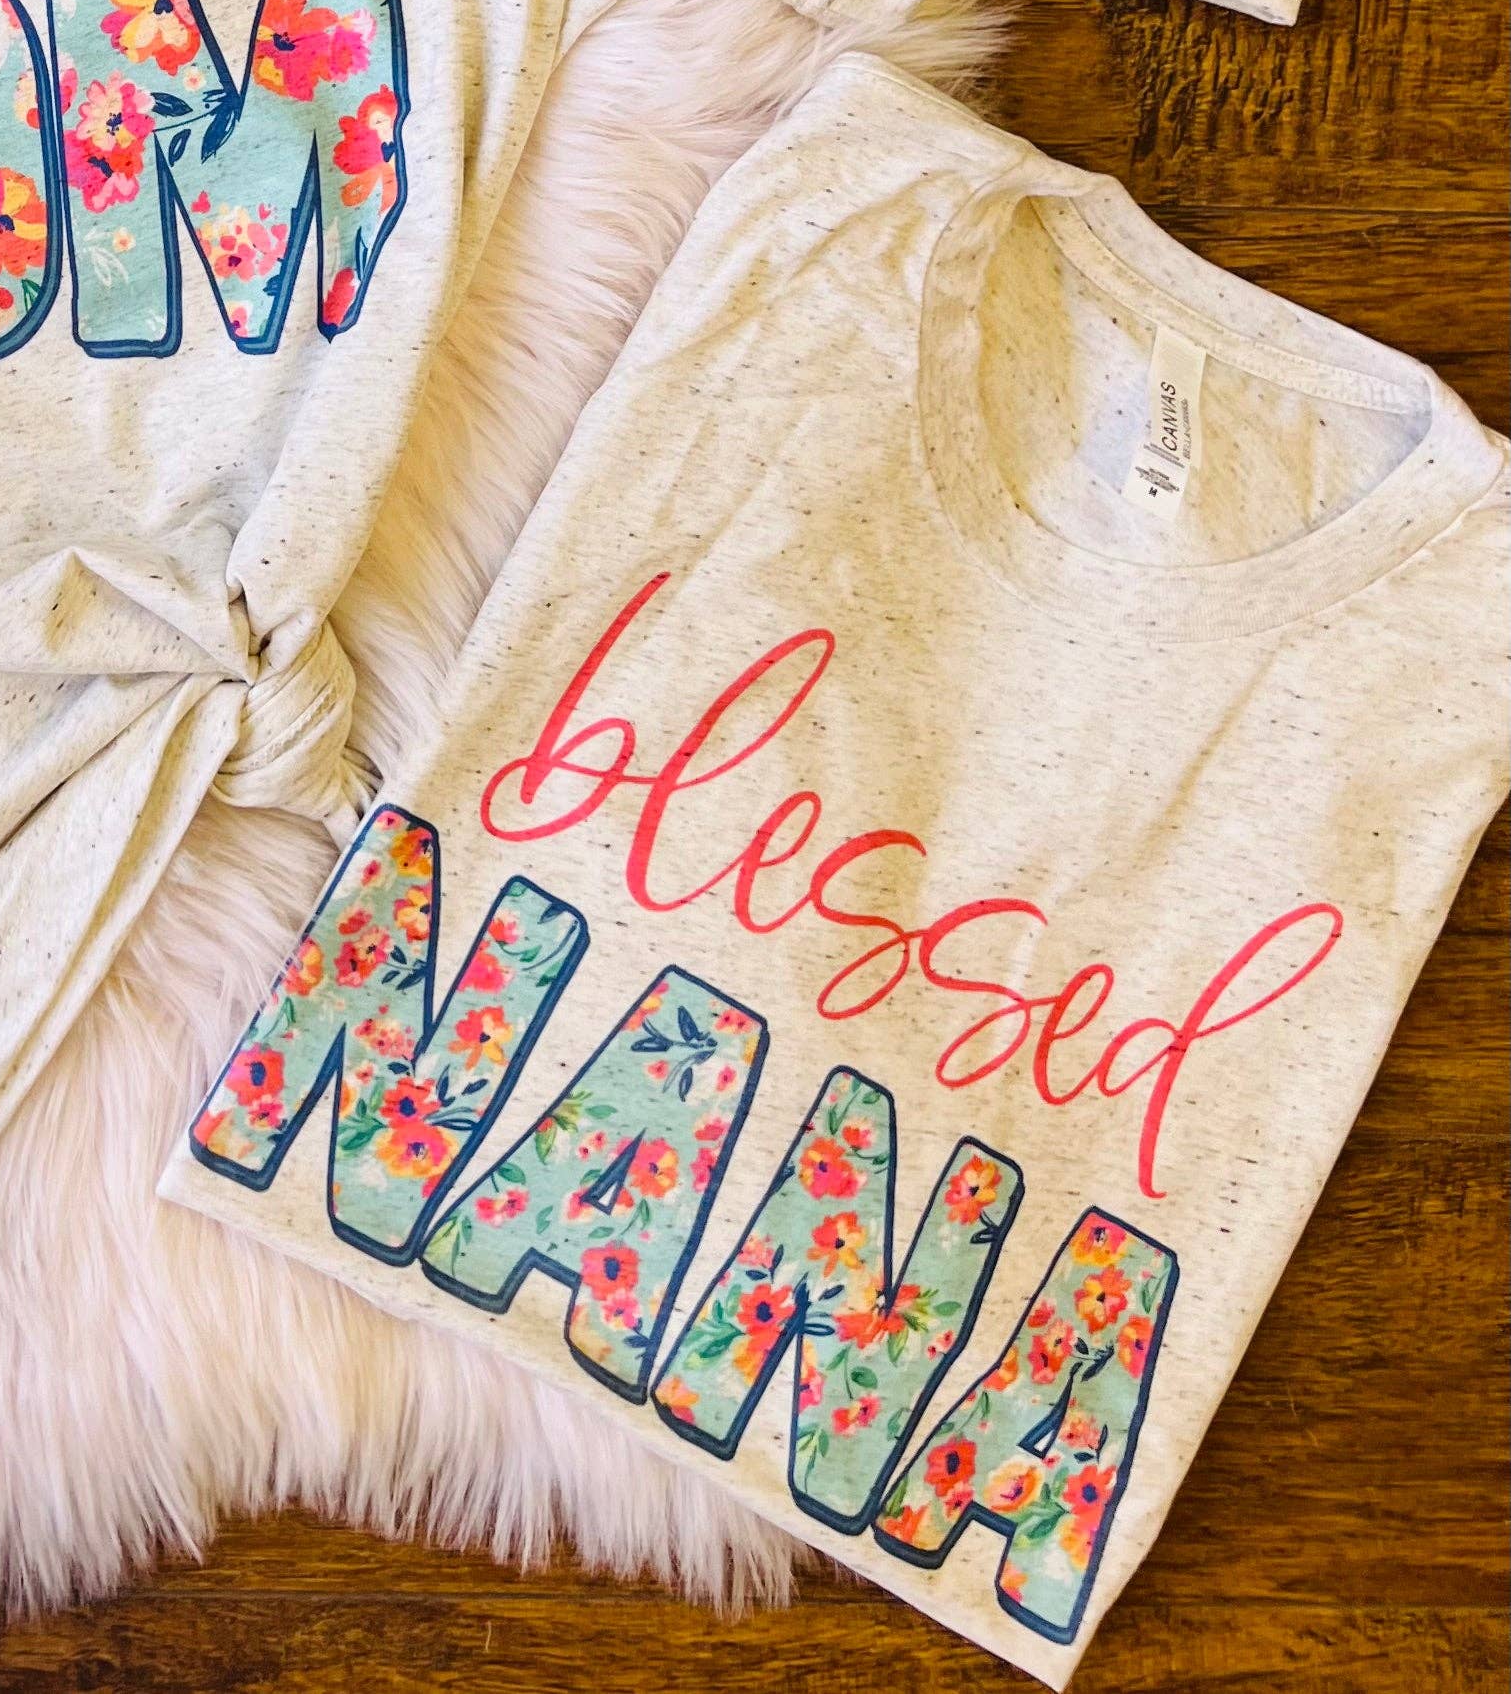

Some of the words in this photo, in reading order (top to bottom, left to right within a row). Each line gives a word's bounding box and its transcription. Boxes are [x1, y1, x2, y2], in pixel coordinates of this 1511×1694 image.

[1161, 380, 1178, 452] CANVAS
[480, 571, 1345, 1199] blessed
[188, 802, 1182, 1647] NANA
